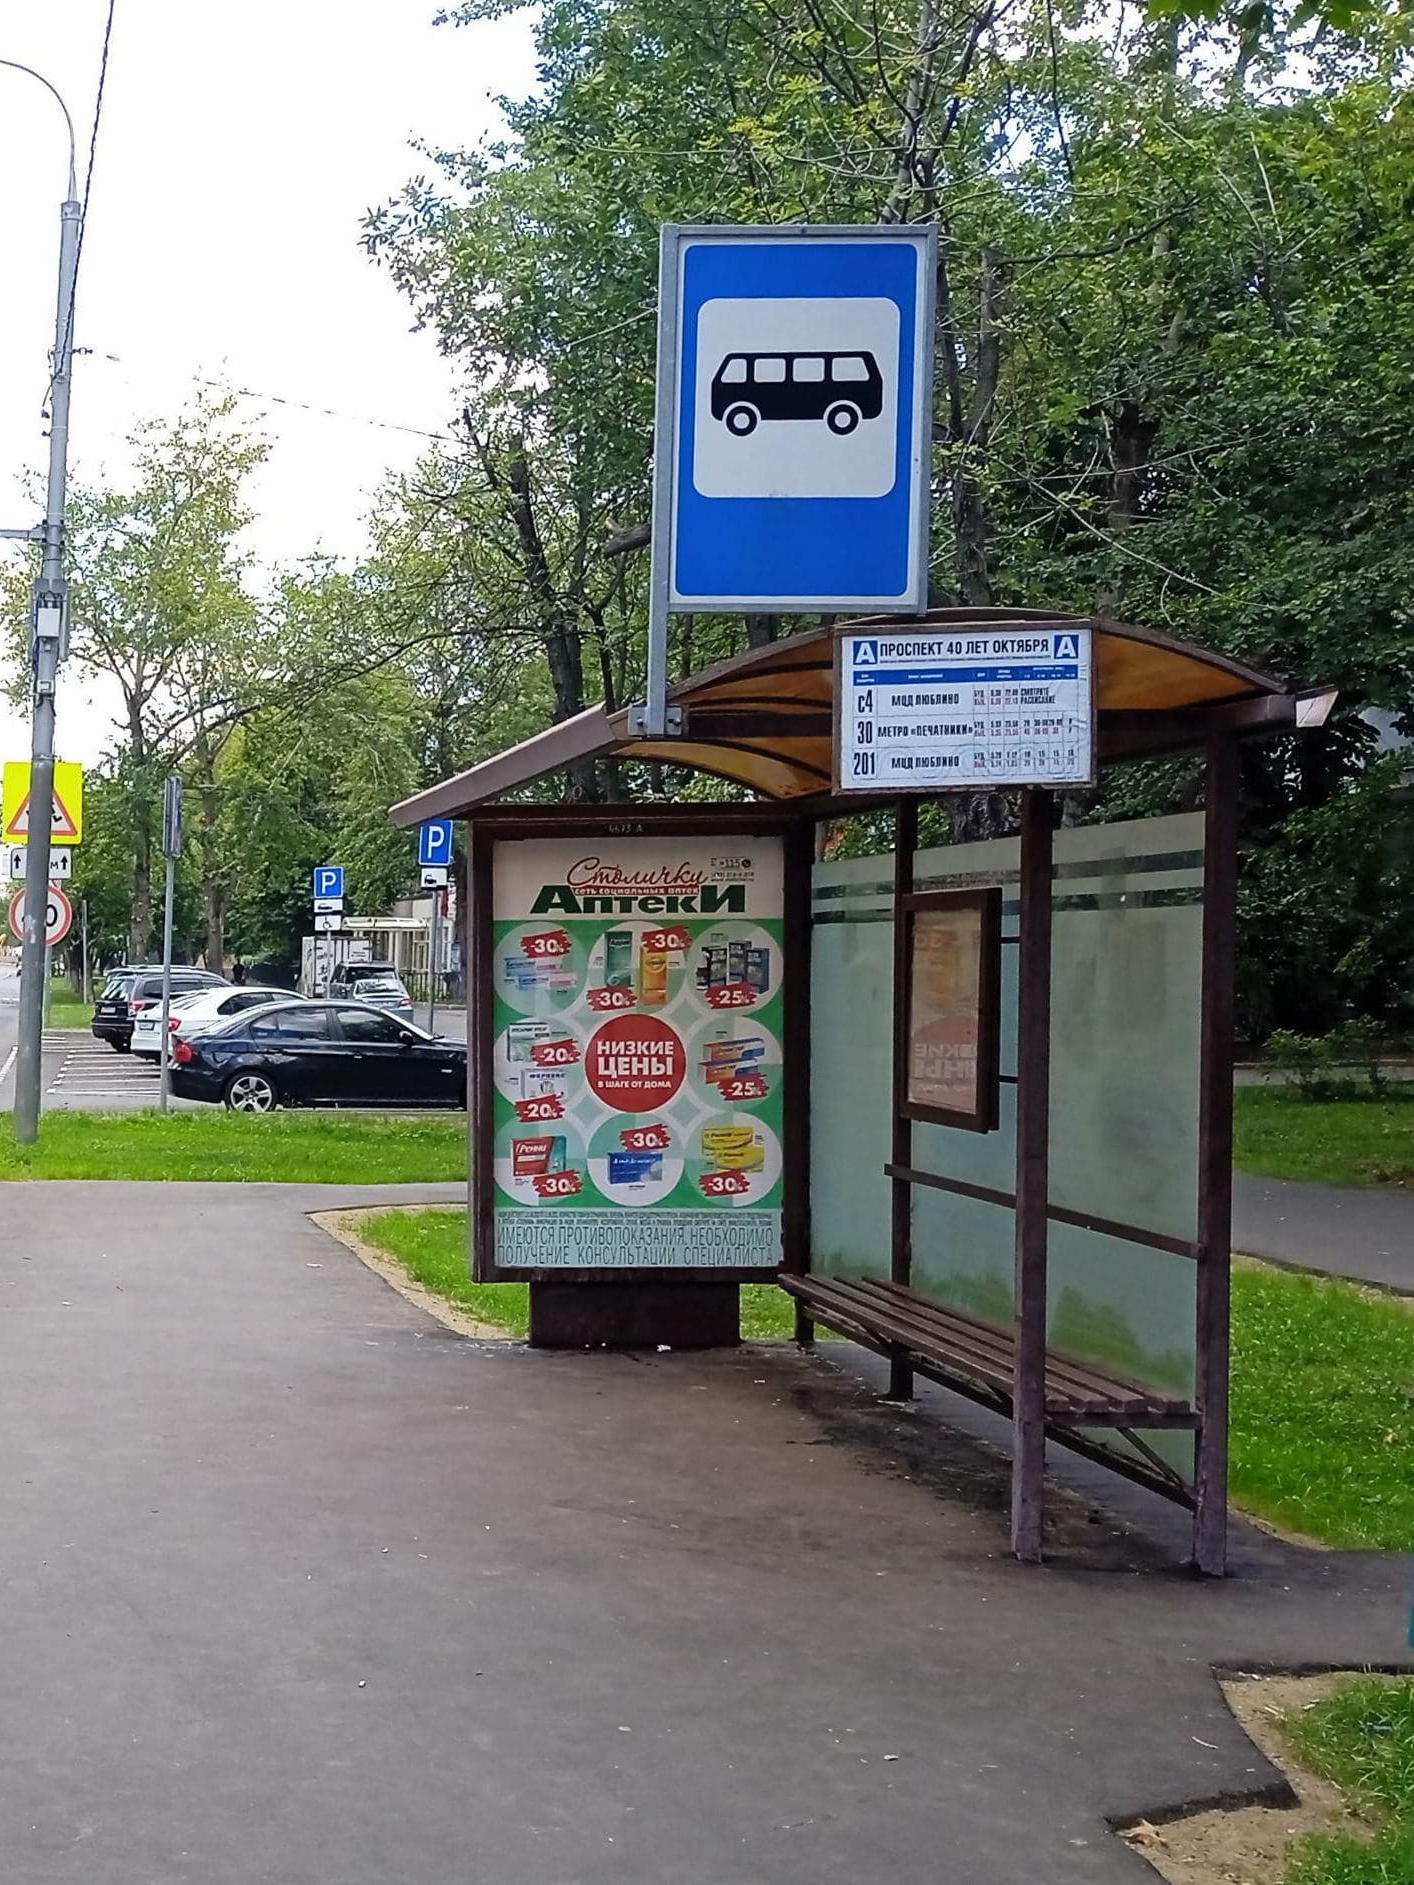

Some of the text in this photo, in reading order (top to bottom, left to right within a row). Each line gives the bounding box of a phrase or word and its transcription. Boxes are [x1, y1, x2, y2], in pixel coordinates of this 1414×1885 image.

[880, 639, 1049, 656] ПРОСПЕКТ 40 ЛЕТ ОКТЯБРЯ
[891, 694, 914, 707] МЦД
[915, 693, 959, 705] ЛЮБЛИНО
[858, 721, 873, 744] 30
[878, 726, 909, 737] МЕТРО
[854, 752, 959, 775] 201 МЦД ЛЮБЛИНО
[427, 826, 444, 858] P
[567, 857, 708, 886] Столички
[322, 872, 336, 894] P
[575, 887, 596, 895] сеть
[599, 887, 665, 896] социальных
[597, 1041, 674, 1055] НИЗКИЕ
[598, 1057, 673, 1079] ЦЕНЫ
[644, 1081, 671, 1089] ДОМА
[498, 1226, 555, 1245] ИМЕЮТСЯ
[691, 1227, 773, 1247] НЕОБХОДИМО
[497, 1245, 772, 1266] ПОЛУЧЕНИЕ КОНСУЛЬТАЦИИ СПЕЦИАЛИСТА
